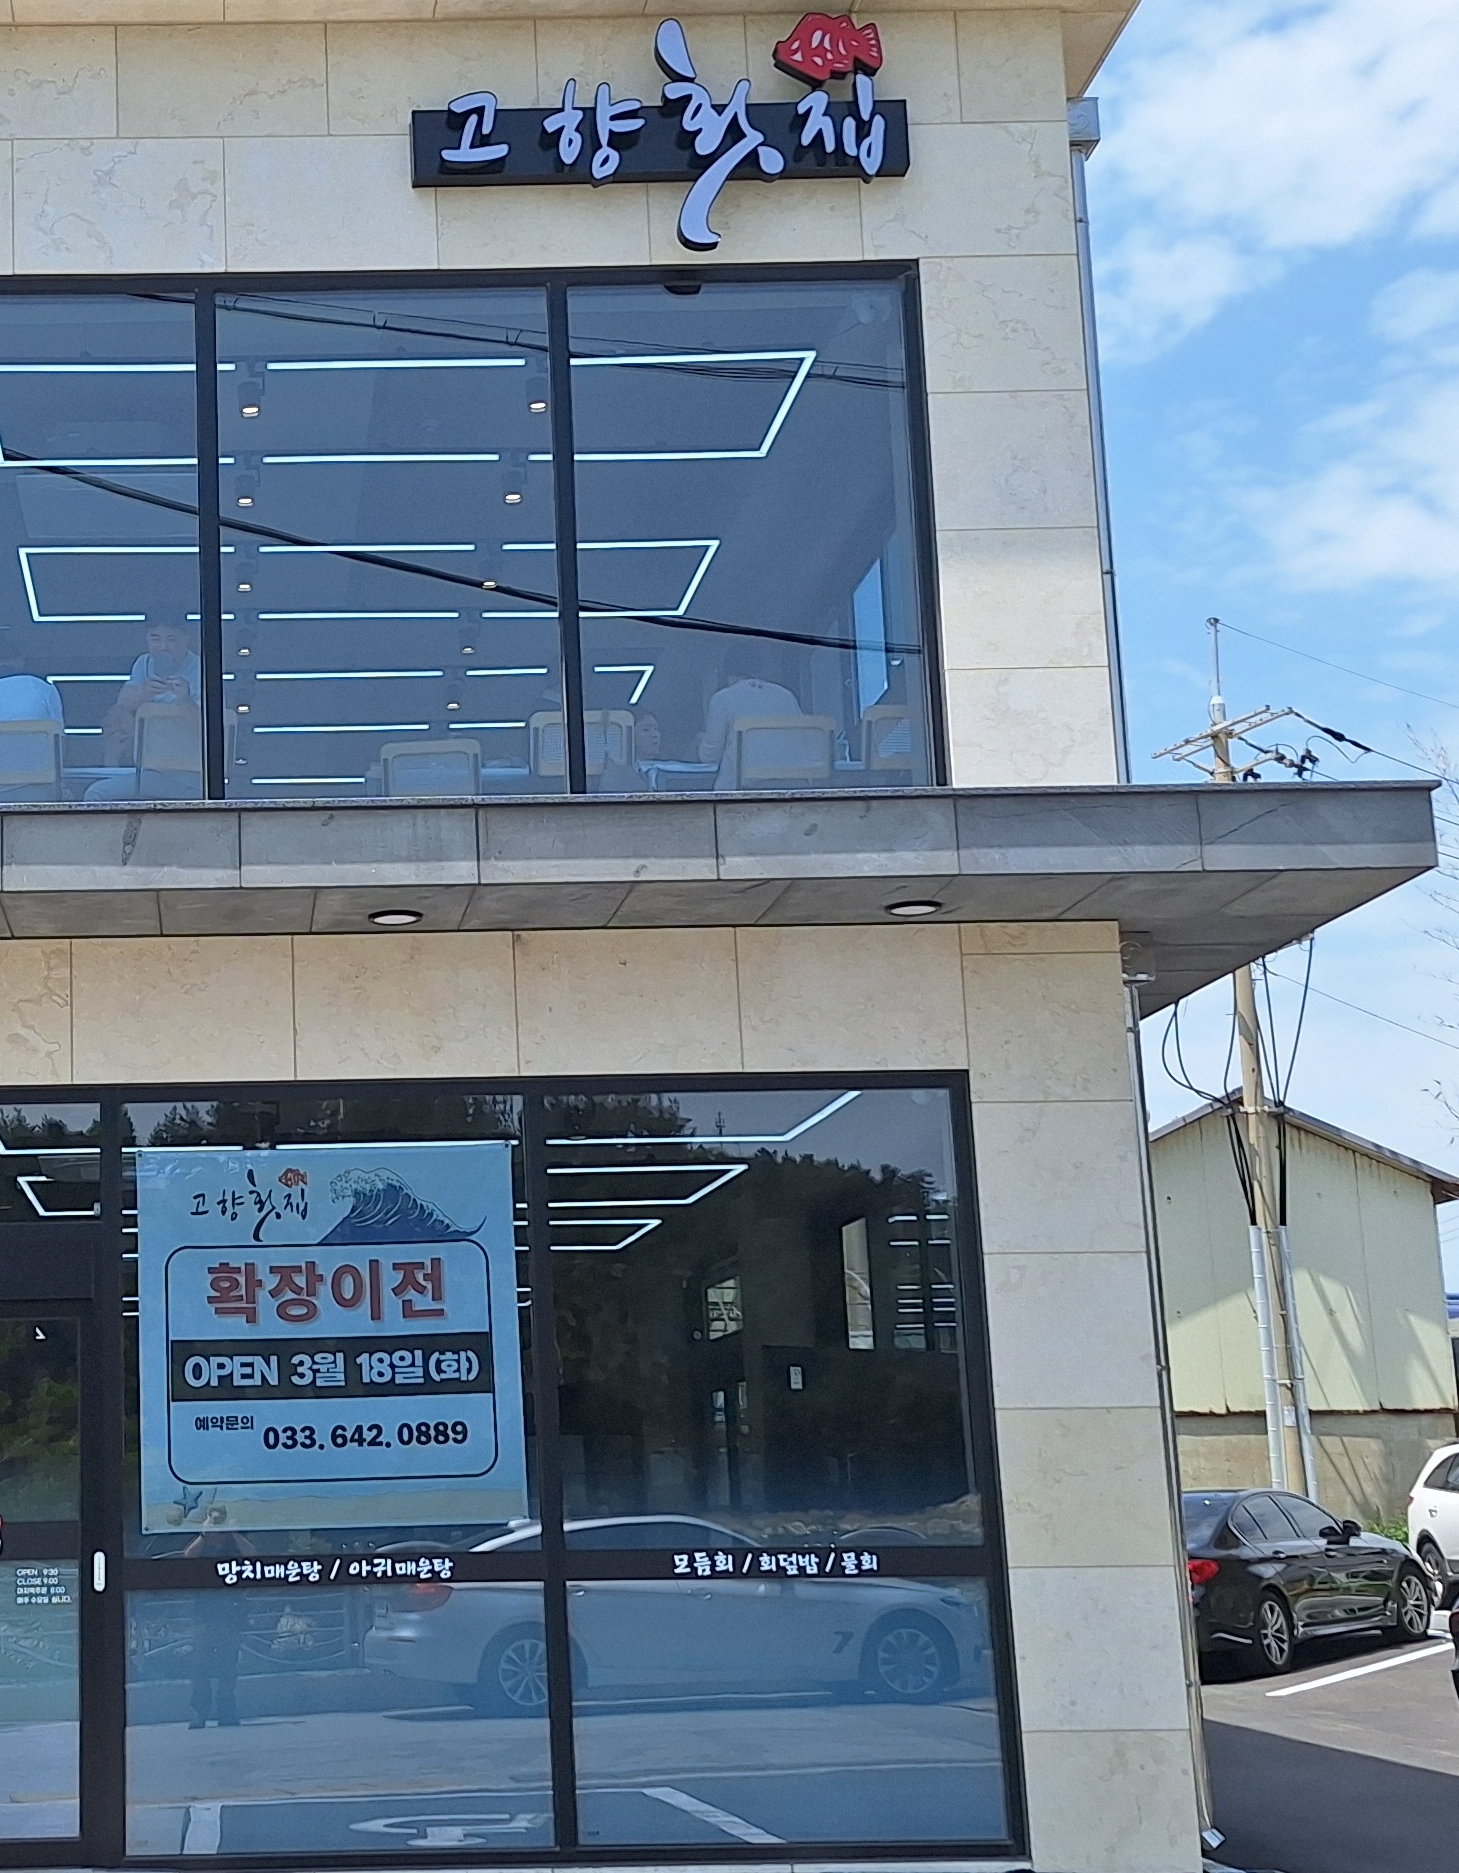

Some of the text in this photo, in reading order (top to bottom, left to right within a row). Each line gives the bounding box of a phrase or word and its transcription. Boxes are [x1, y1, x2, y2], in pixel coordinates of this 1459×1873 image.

[206, 1257, 446, 1325] 확장이전
[184, 1349, 480, 1388] OPEN 3월 18일(화)
[195, 1416, 254, 1432] 예약문의
[263, 1422, 469, 1450] 033.642.0889
[16, 1568, 39, 1576] OPEN
[216, 1559, 322, 1584] 망치매운탕
[348, 1557, 454, 1579] 아귀매운탕
[673, 1552, 734, 1576] 모듬회
[759, 1553, 819, 1575] 회덮밥
[841, 1552, 879, 1574] 물회
[16, 1577, 42, 1585] CLOSE
